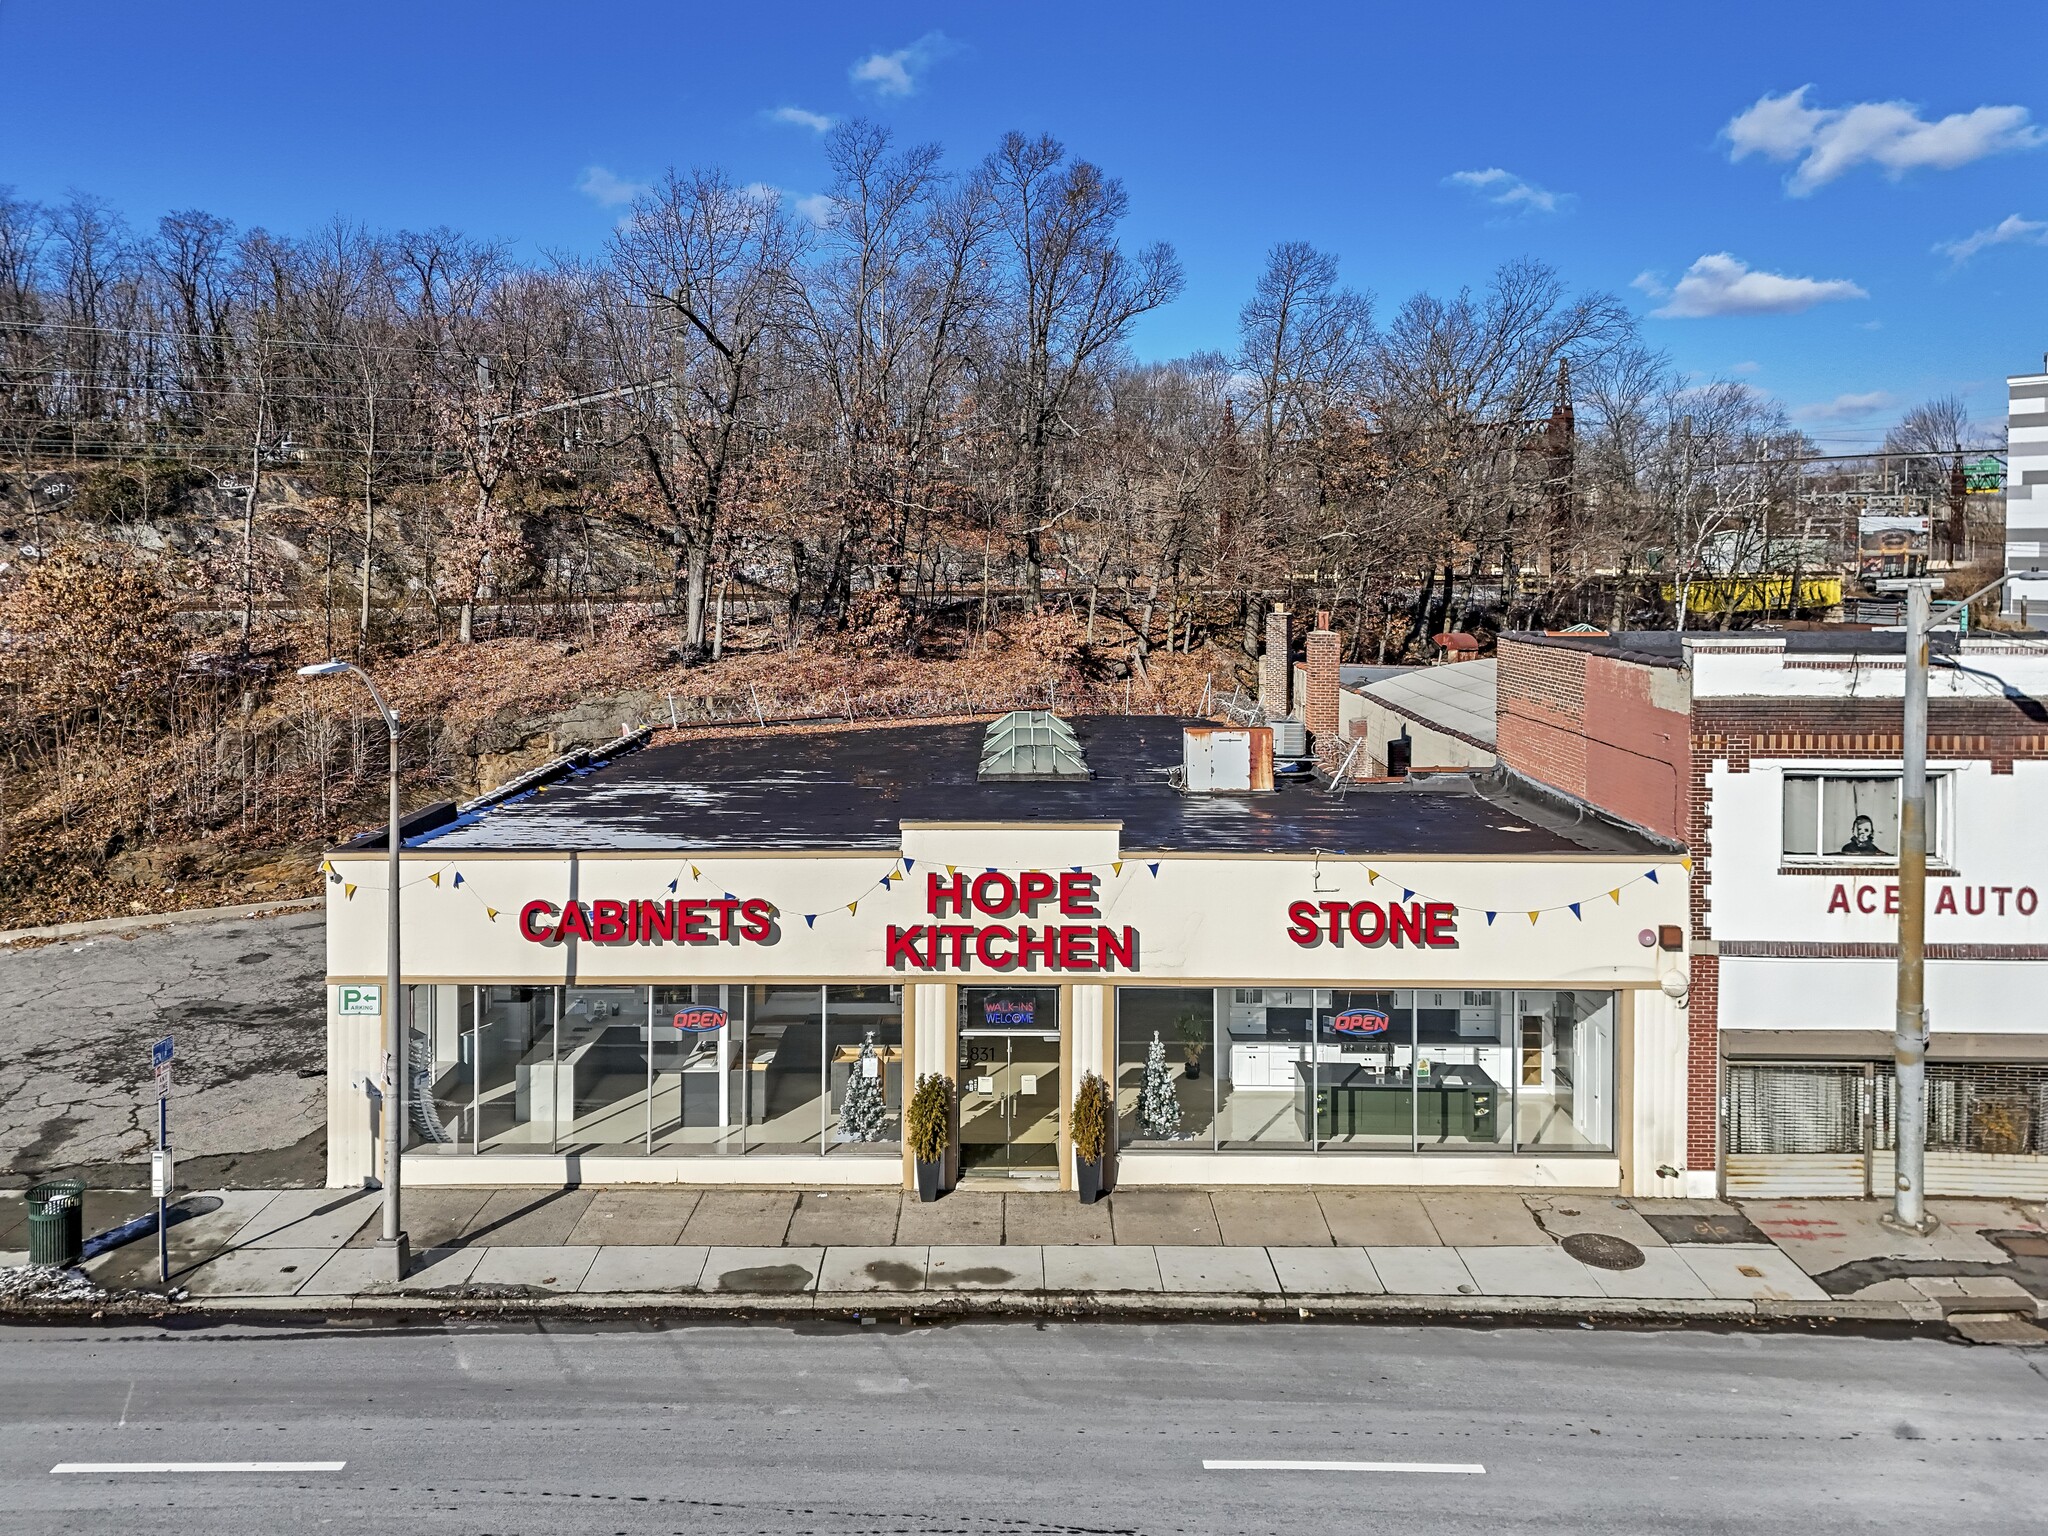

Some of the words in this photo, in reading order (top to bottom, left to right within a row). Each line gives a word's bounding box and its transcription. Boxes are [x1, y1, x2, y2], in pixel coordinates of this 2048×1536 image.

[927, 871, 1099, 916] HOPE
[1827, 883, 1899, 914] ACE
[1933, 885, 2039, 916] AUTO
[519, 898, 772, 943] CABINETS
[1287, 900, 1456, 945] STONE
[886, 924, 1134, 969] KITCHEN
[985, 1001, 1034, 1012] WALK-INS
[985, 1012, 1034, 1024] WELCOME
[673, 1011, 727, 1028] OPEN
[1334, 1014, 1389, 1031] OPEN
[970, 1046, 995, 1061] 831
